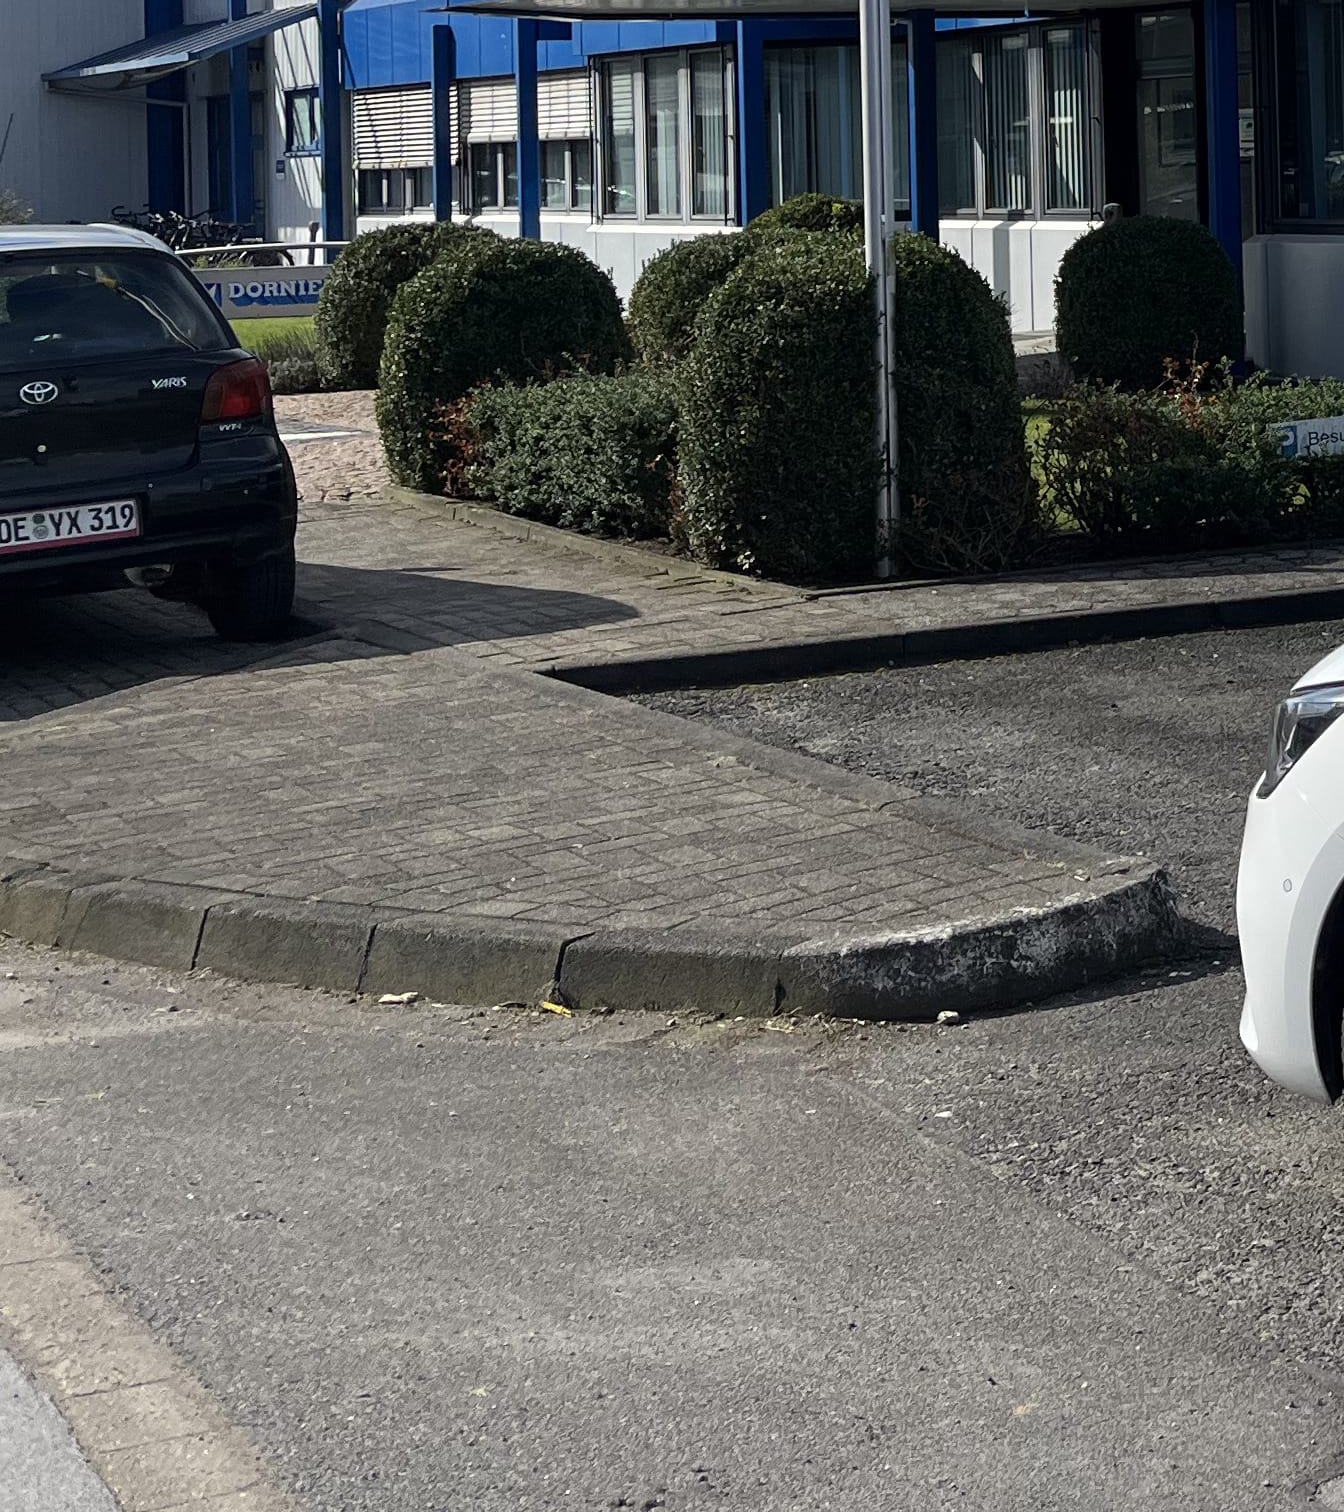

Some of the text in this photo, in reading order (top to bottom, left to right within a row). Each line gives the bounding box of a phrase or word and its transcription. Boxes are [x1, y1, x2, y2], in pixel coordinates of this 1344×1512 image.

[228, 279, 324, 306] DORNIE
[152, 376, 187, 389] YARIS
[48, 509, 82, 537] YX
[87, 503, 135, 532] 319
